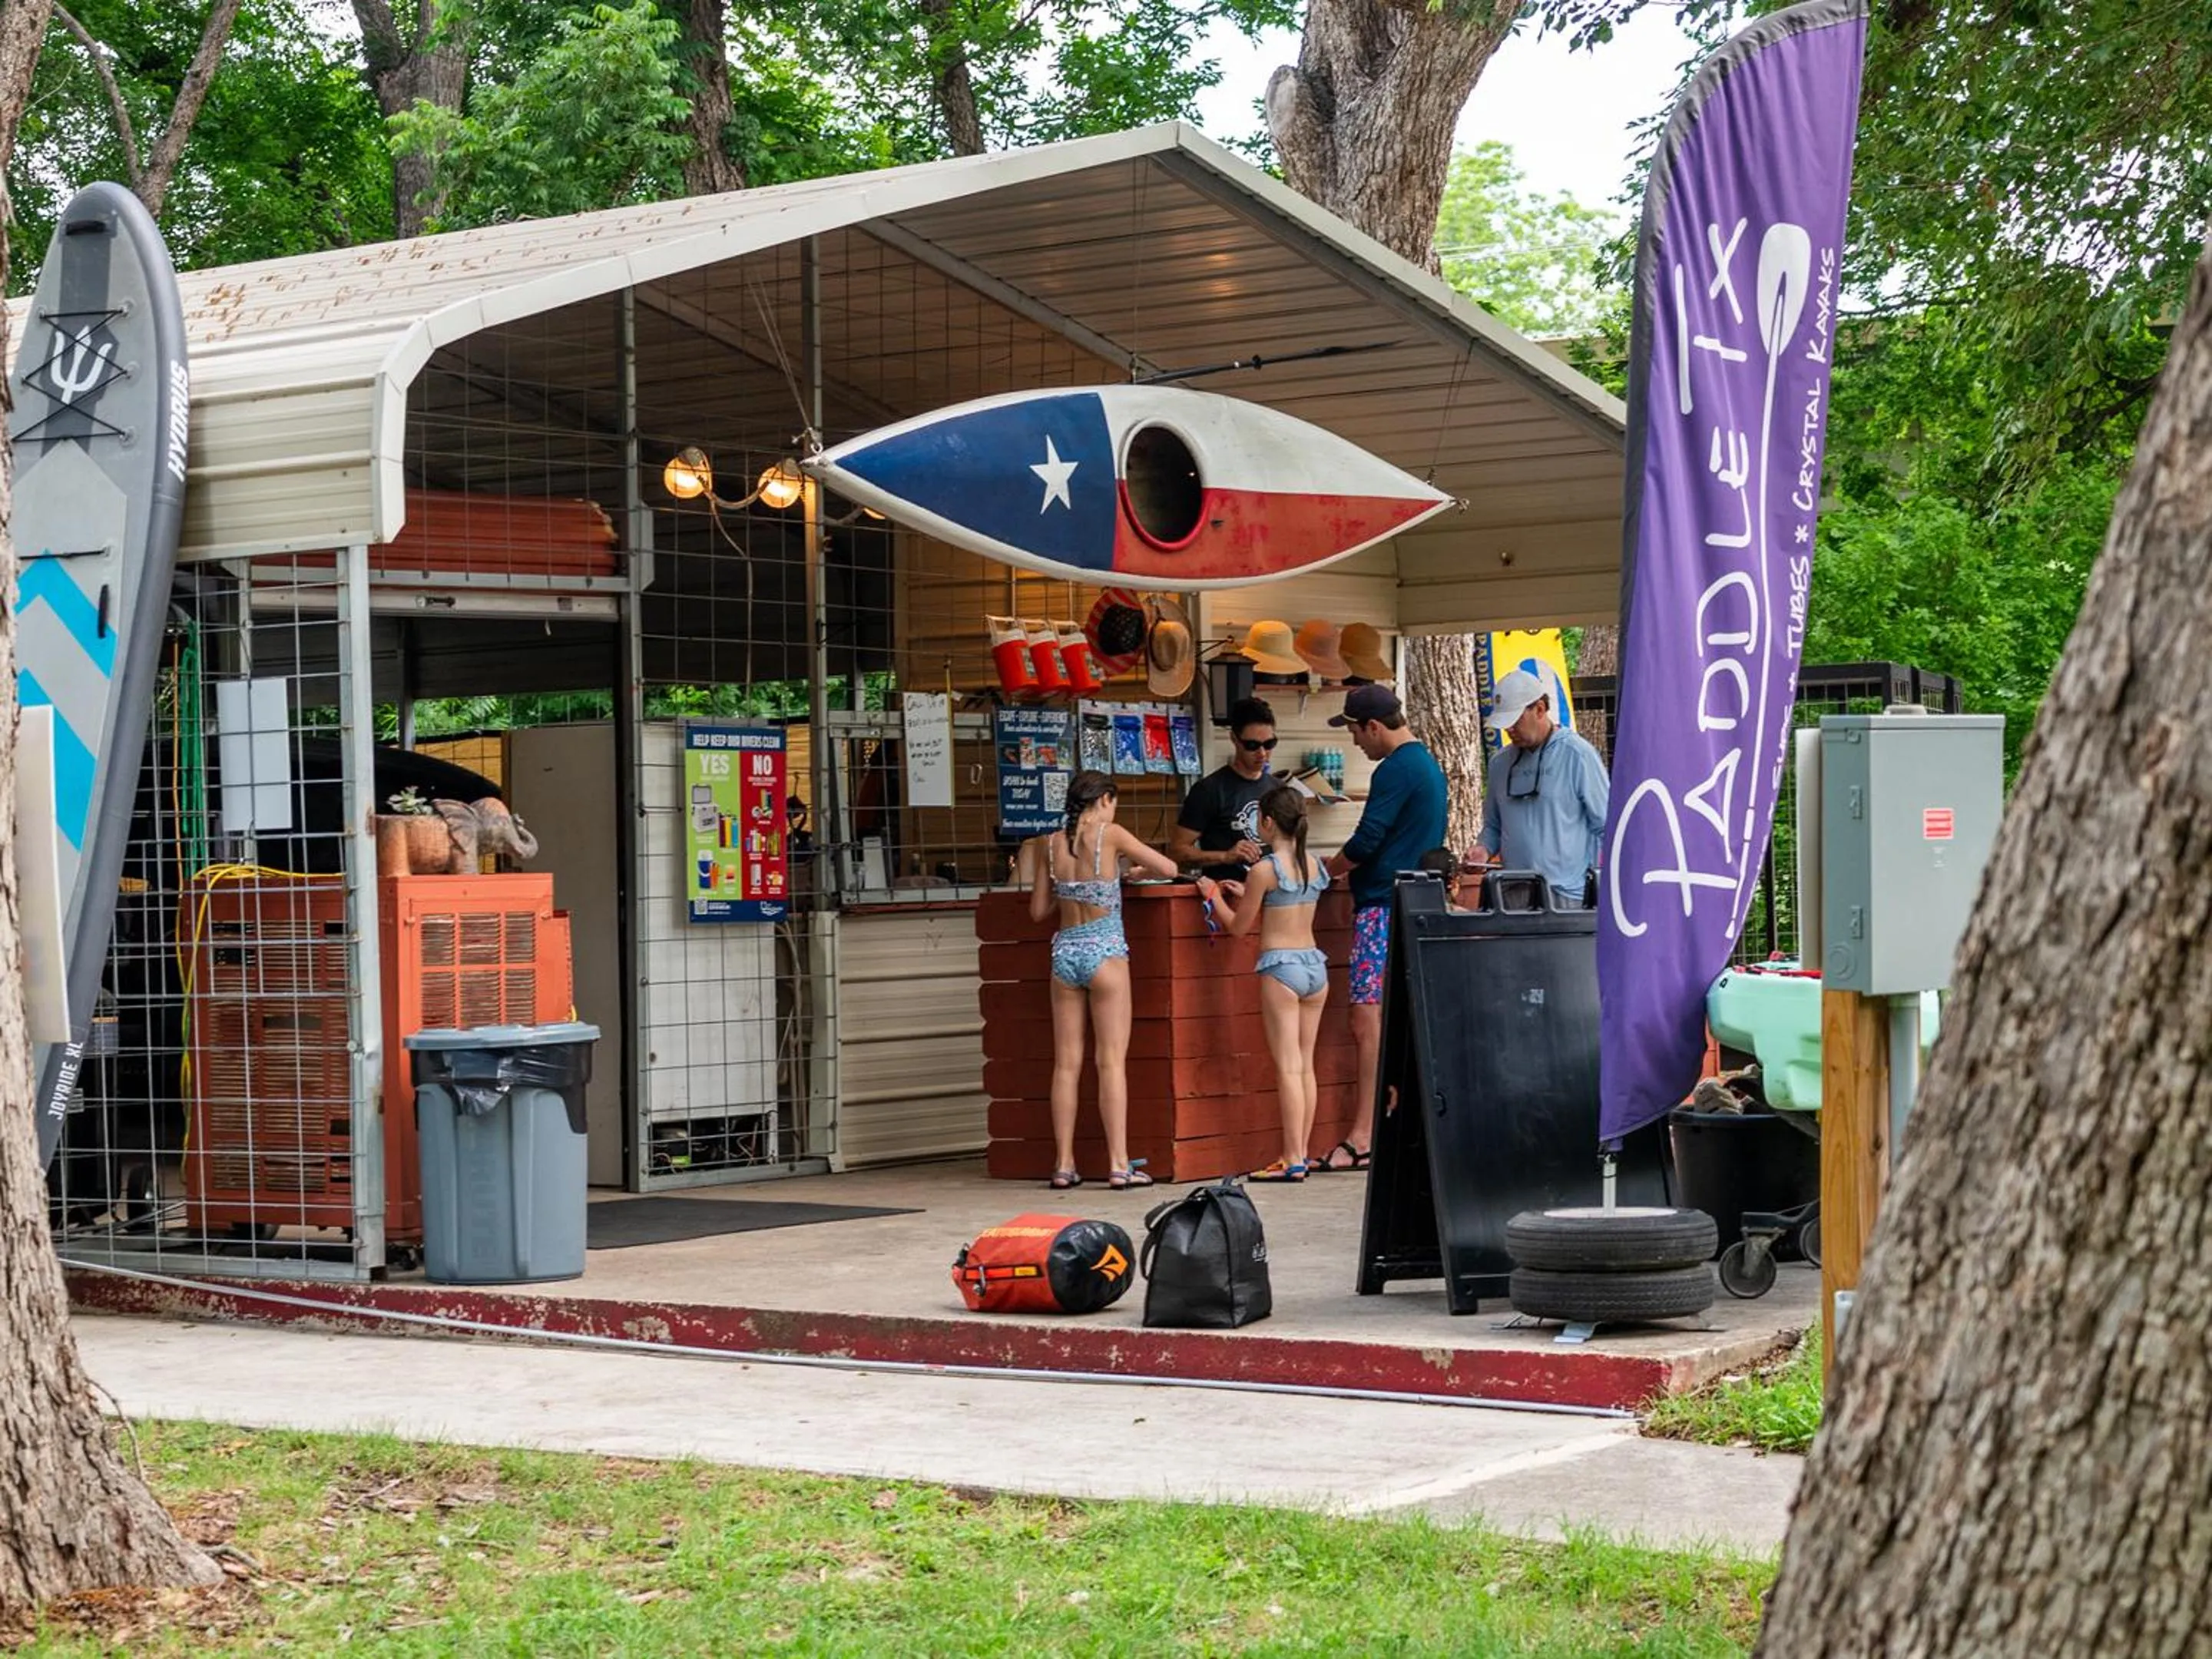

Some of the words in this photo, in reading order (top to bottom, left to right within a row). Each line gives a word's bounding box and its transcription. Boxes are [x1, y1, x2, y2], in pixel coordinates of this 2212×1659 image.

[1675, 217, 1747, 414] TX
[1806, 247, 1835, 364] KAYAKS
[167, 359, 188, 483] HYDRUS
[1792, 378, 1820, 512] CRYSTAL
[1787, 556, 1809, 658] TUBES
[1610, 426, 1758, 937] PADDLE
[700, 753, 730, 775] YES
[753, 755, 772, 776] NO
[48, 1061, 78, 1120] JOYRIDE
[65, 1042, 84, 1058] XL
